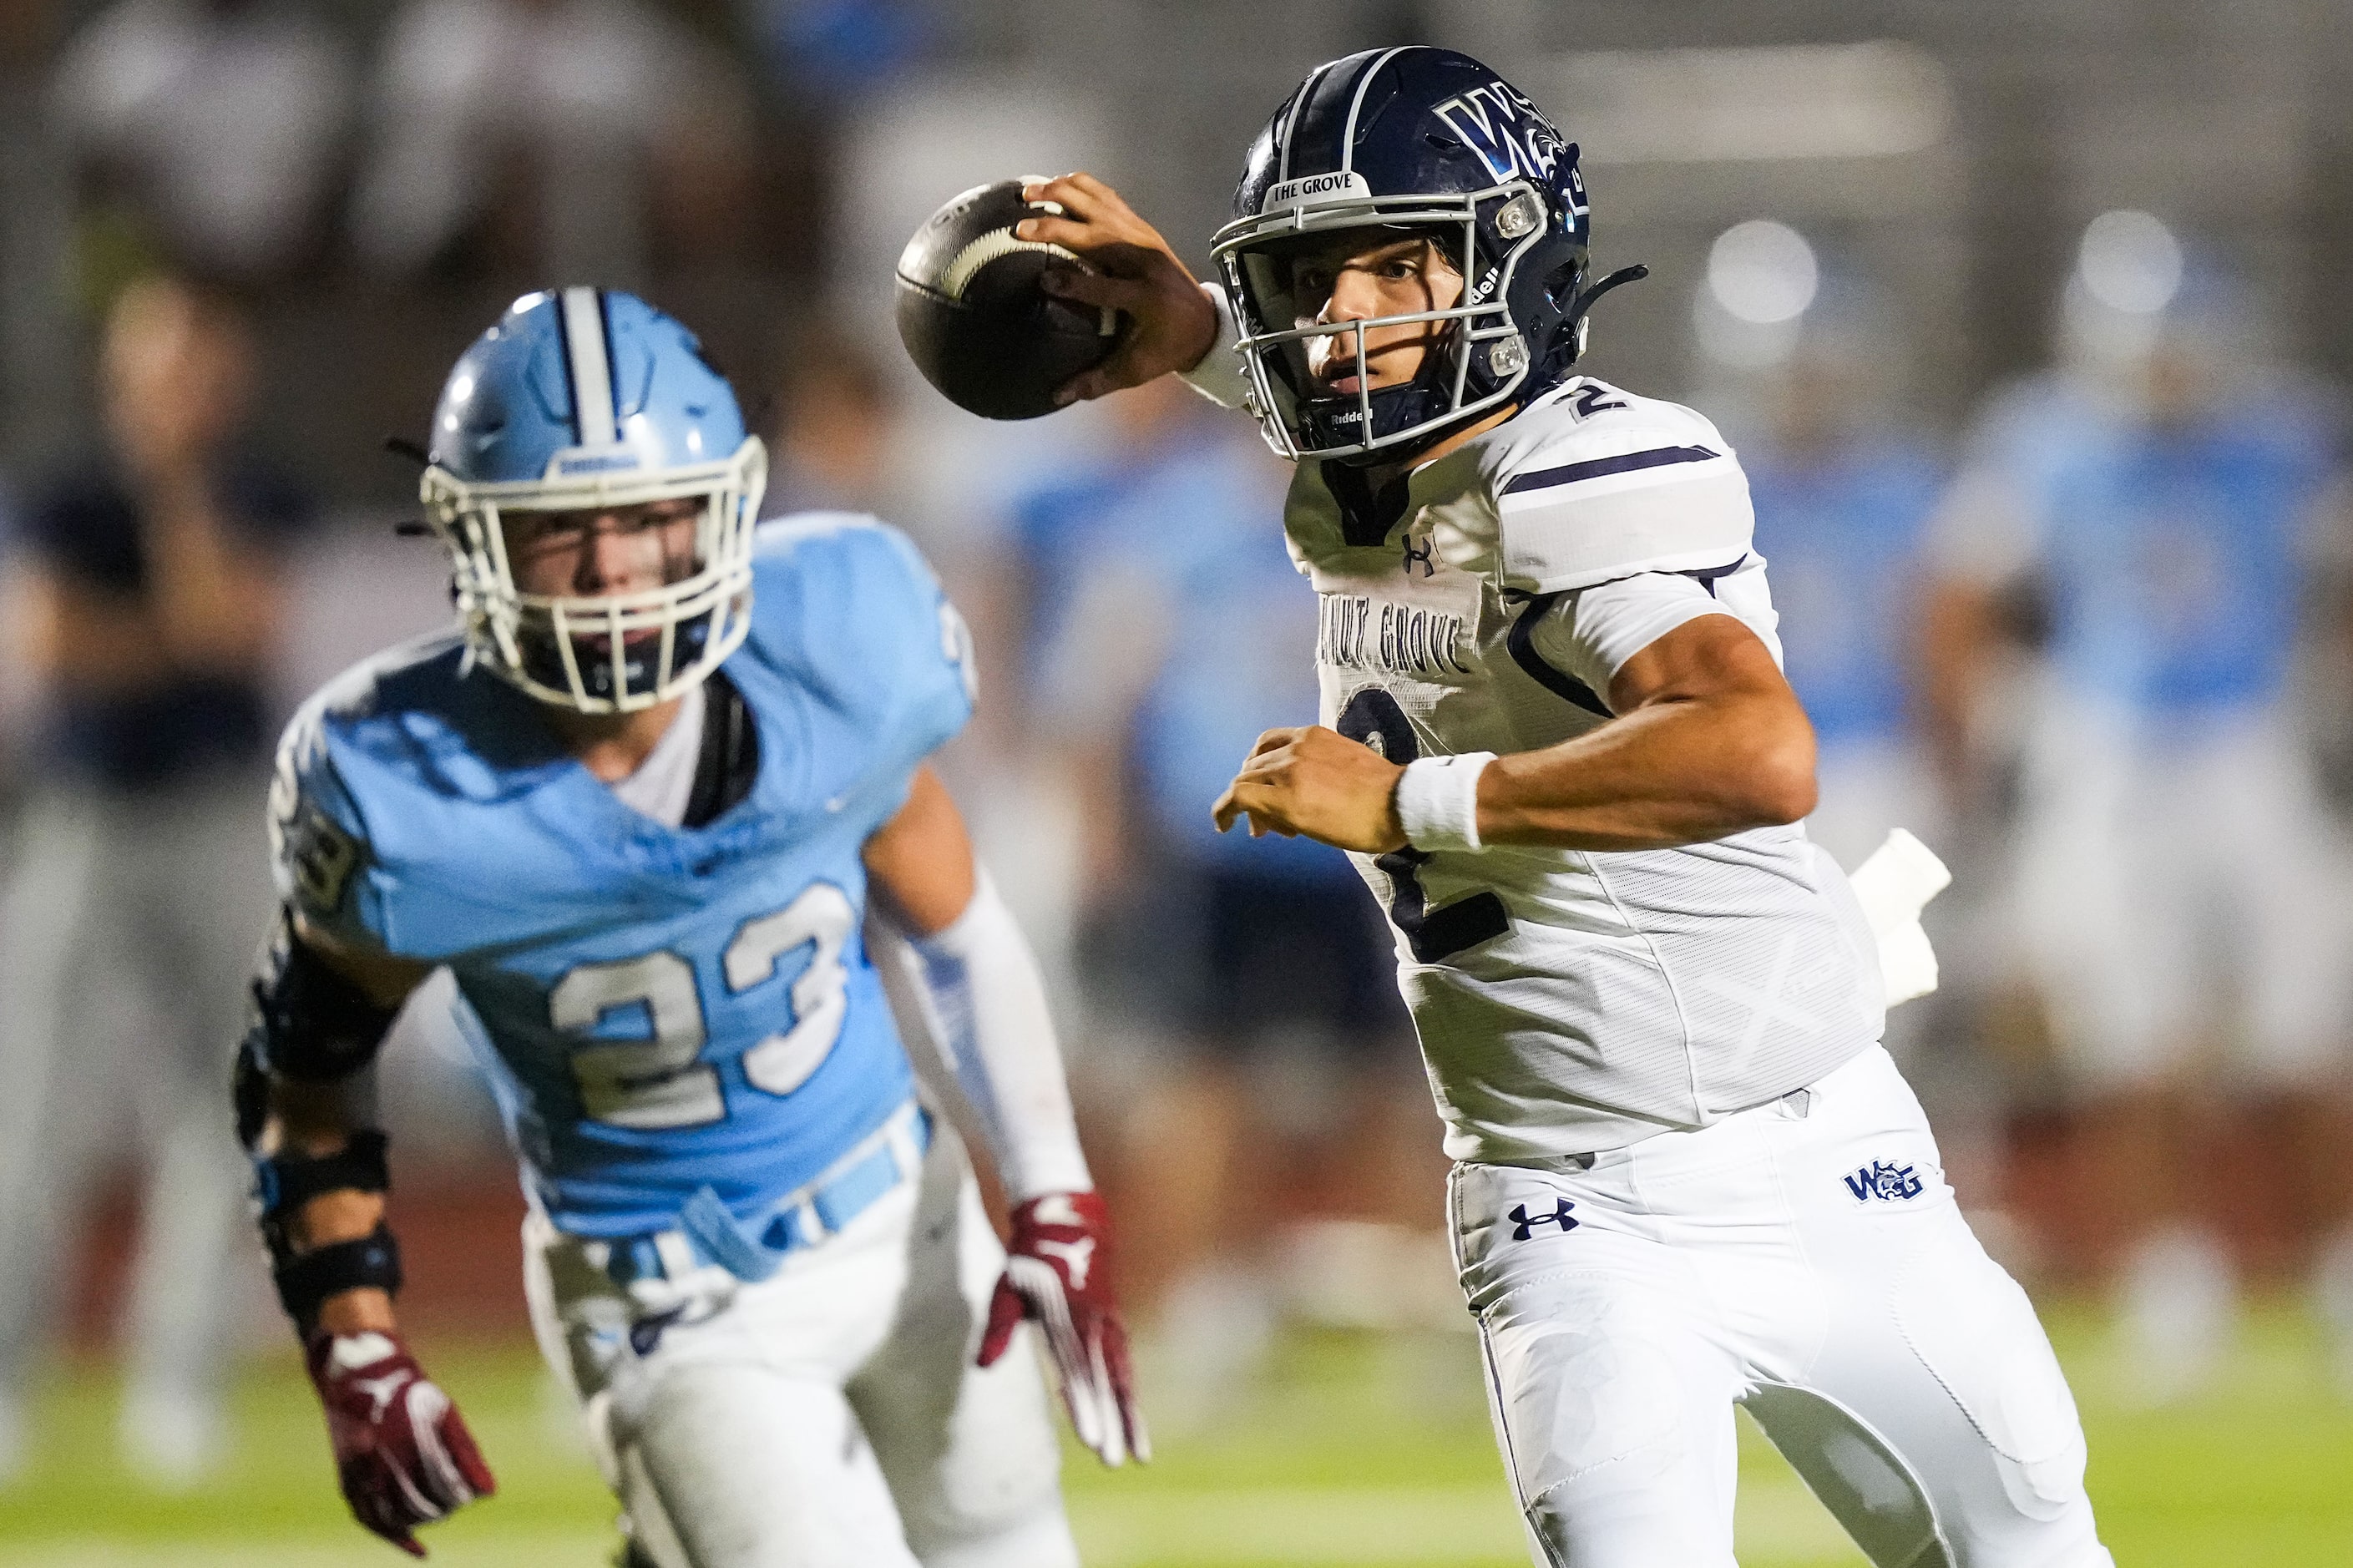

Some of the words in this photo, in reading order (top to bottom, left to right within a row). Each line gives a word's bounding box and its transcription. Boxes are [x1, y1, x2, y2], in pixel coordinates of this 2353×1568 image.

[1274, 183, 1298, 202] THE
[1303, 173, 1353, 195] GROVE
[1331, 407, 1374, 426] Riddel
[1566, 380, 1636, 424] 2
[1380, 602, 1470, 674] GROVE
[1336, 687, 1510, 964] 2
[548, 879, 855, 1131] 23
[1841, 1158, 1925, 1203] WG
